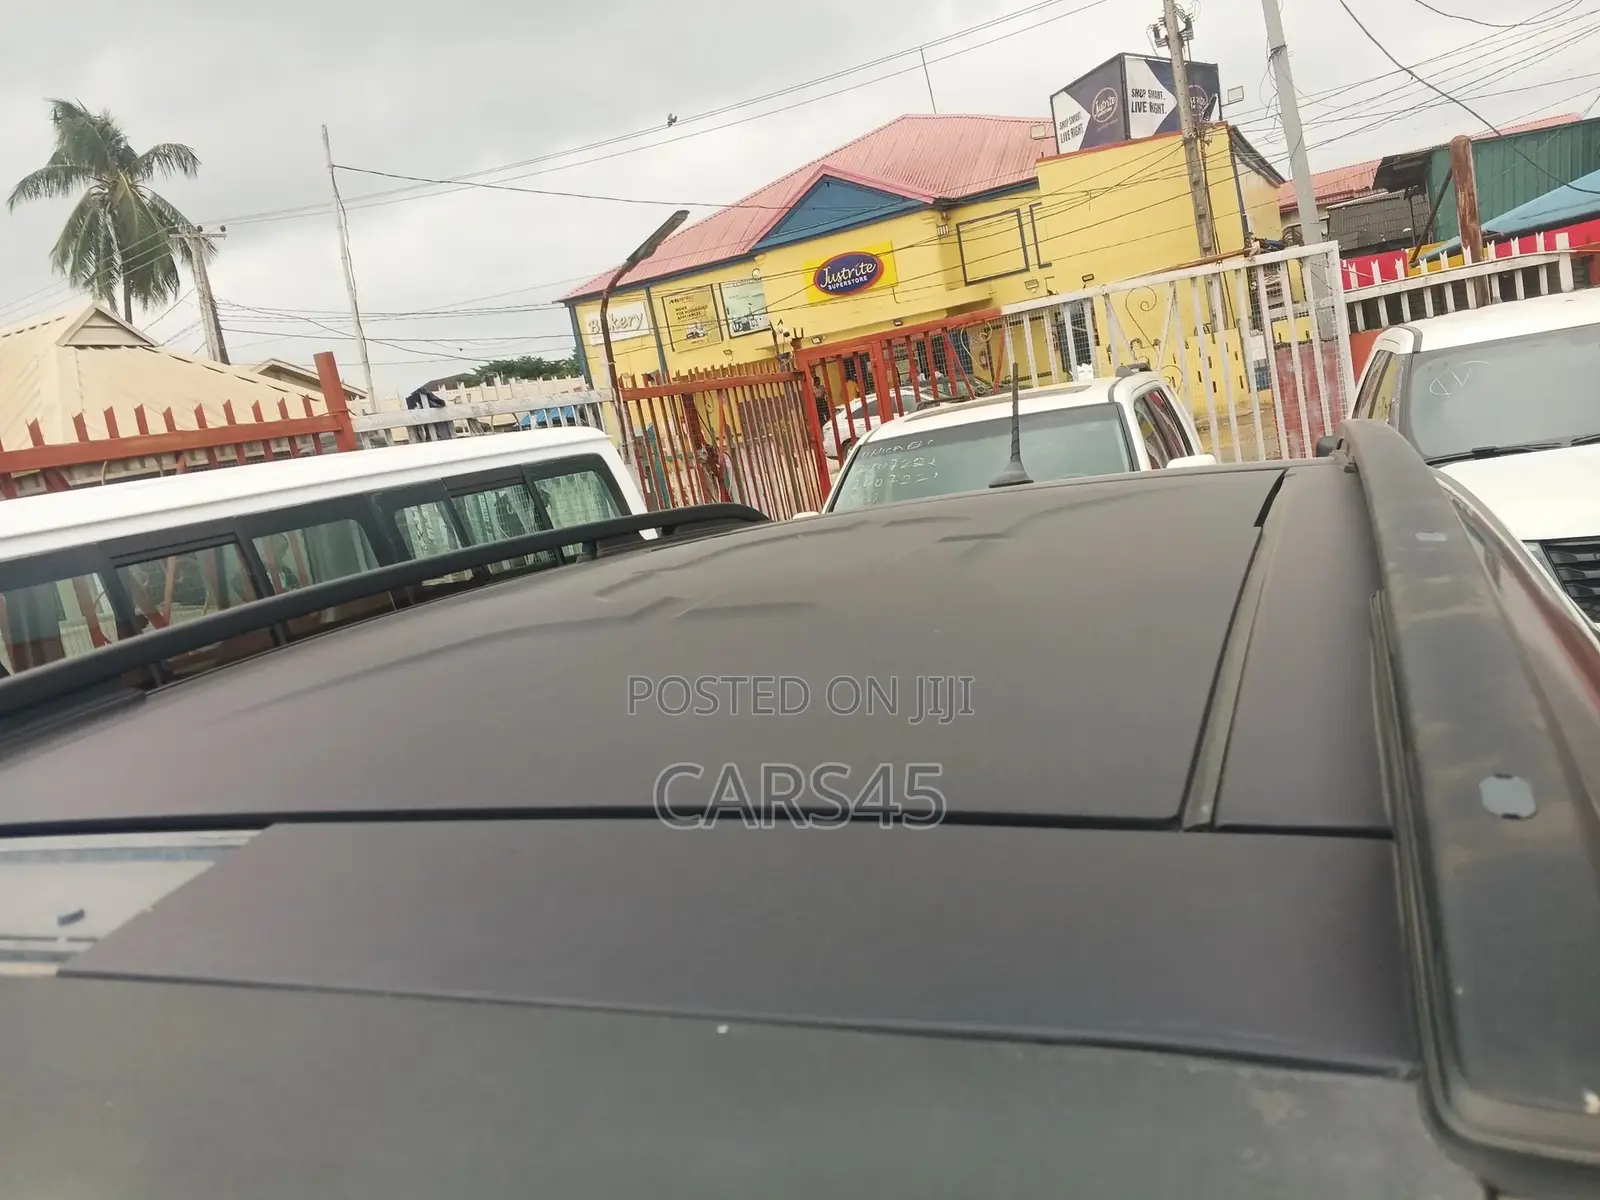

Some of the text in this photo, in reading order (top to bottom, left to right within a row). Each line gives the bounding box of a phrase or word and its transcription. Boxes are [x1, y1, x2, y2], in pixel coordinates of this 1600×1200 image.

[1131, 88, 1146, 98] SHOP
[1131, 101, 1147, 113] LIVE
[1060, 129, 1071, 143] LIVE
[820, 262, 877, 288] Justrite
[828, 276, 868, 290] SUPERSTORE
[589, 312, 643, 334] Bkery
